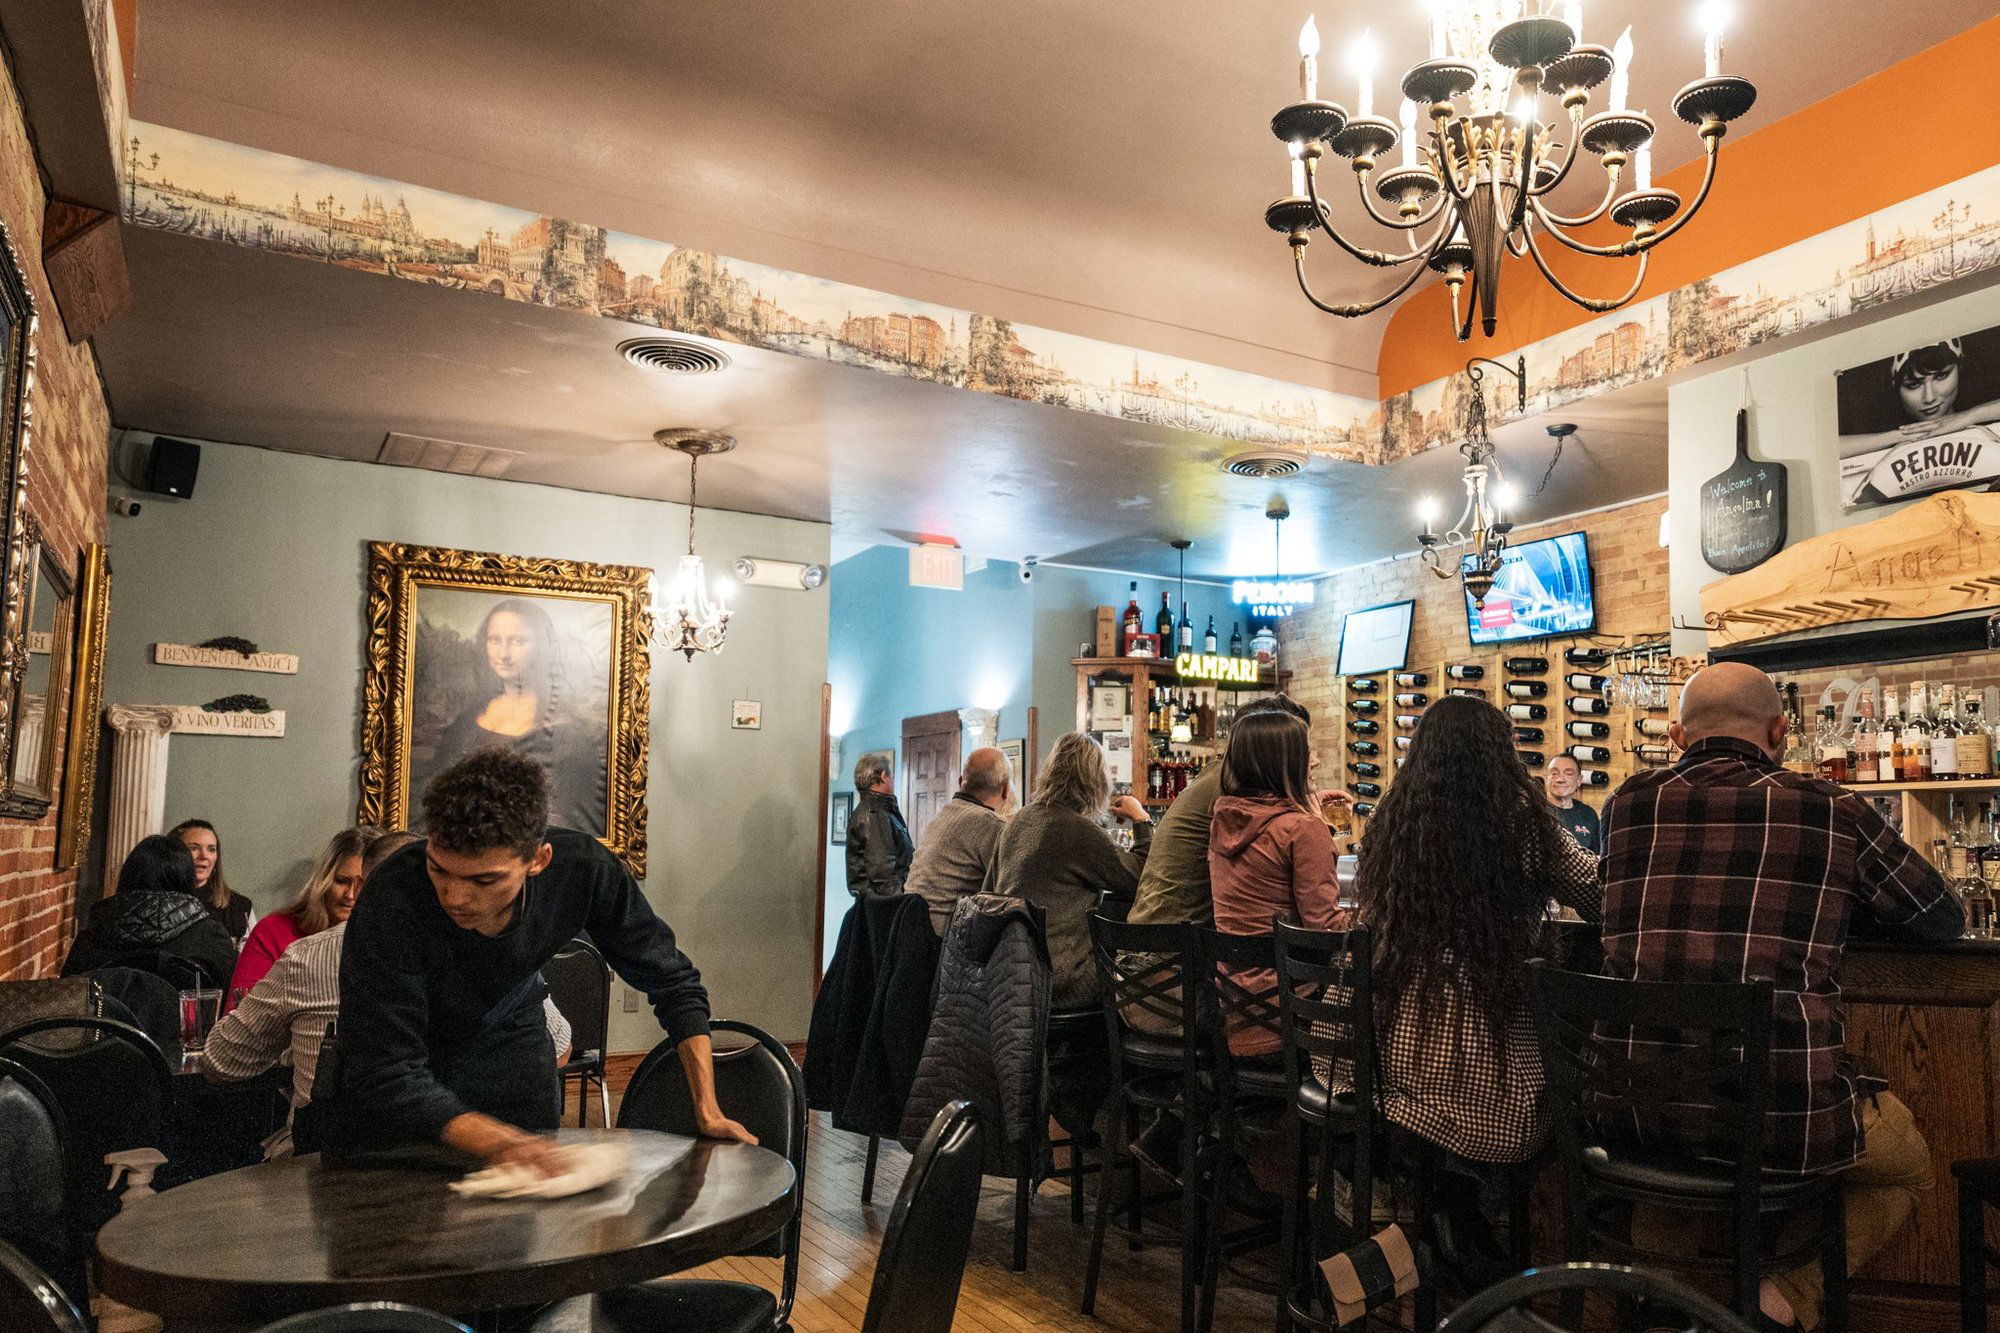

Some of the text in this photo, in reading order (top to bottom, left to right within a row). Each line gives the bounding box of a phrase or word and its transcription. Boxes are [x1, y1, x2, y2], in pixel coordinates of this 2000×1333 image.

[1891, 442, 1983, 483] PERONI
[1710, 469, 1767, 499] Welcome to
[1900, 468, 1973, 492] NASTRO AZZURRO
[921, 552, 956, 581] EXIT
[1252, 605, 1294, 617] ITALY
[163, 647, 292, 671] BENVENUTI AMICI
[1175, 652, 1259, 683] CAMPARI
[187, 713, 220, 728] VINO
[224, 714, 276, 730] VERITAS
